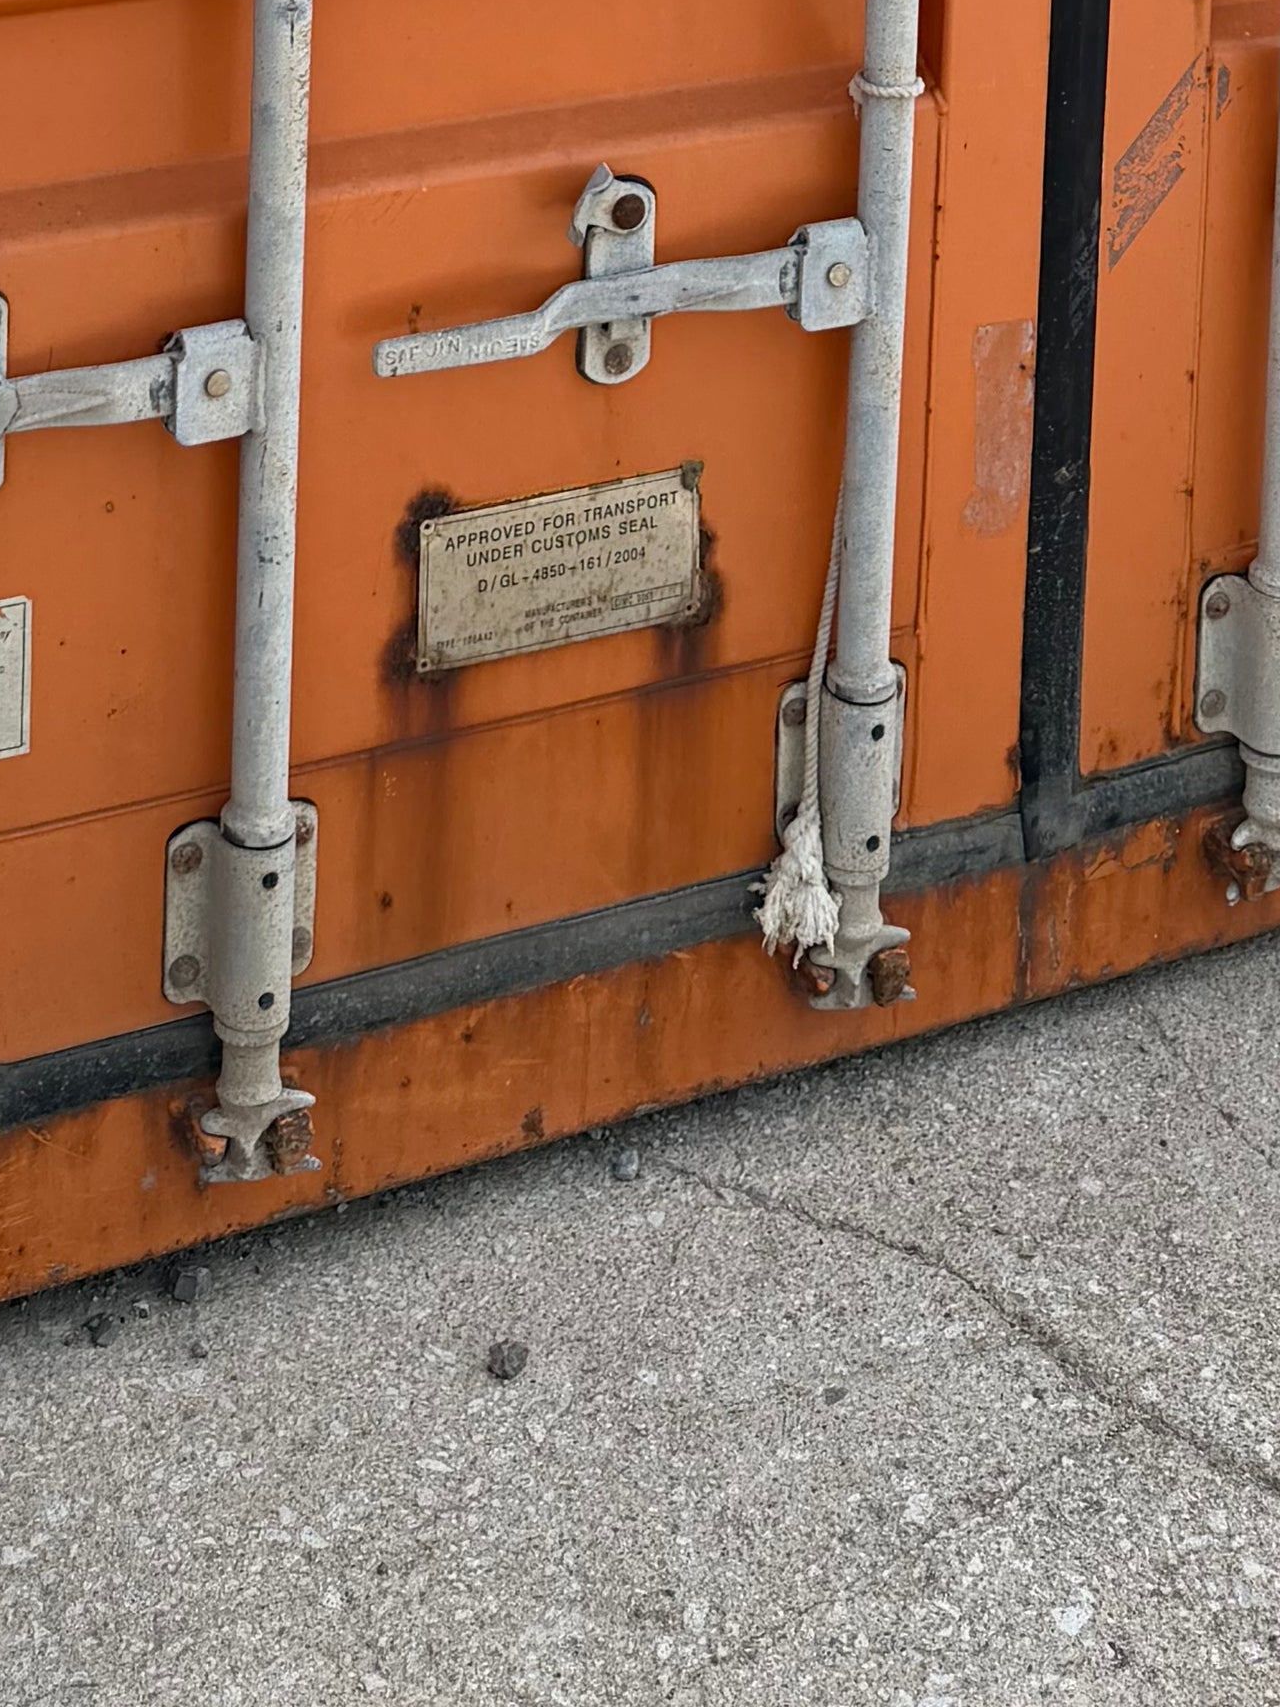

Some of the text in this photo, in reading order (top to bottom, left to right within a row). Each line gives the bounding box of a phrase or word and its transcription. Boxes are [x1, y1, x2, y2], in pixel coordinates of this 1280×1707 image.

[444, 490, 679, 553] APPROVED FOR TRANSPORT
[466, 515, 658, 568] UNDER CUSTOMS SEAL
